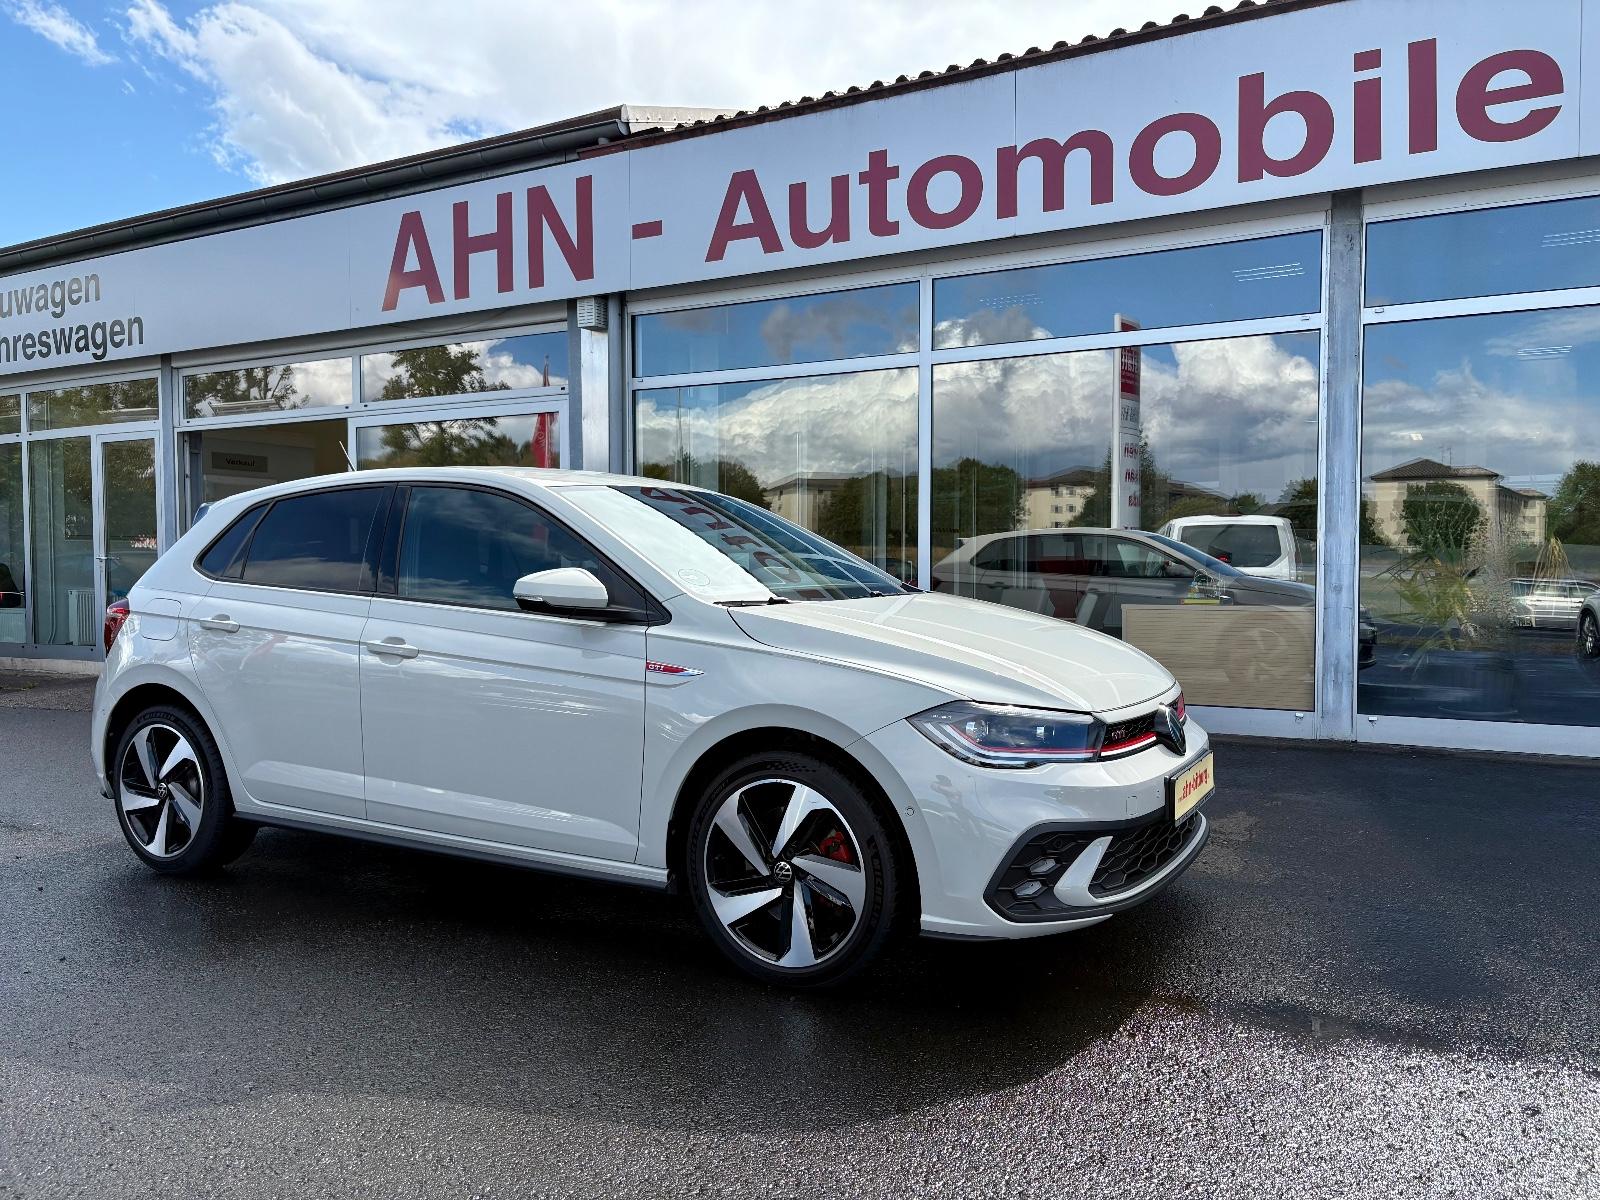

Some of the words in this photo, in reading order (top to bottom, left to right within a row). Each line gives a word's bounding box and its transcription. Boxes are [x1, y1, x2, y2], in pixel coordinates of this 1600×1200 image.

[382, 175, 594, 311] AHN
[632, 219, 663, 240] -
[705, 38, 1564, 262] Automobile
[225, 456, 255, 466] Verkauf
[648, 664, 665, 672] GTI
